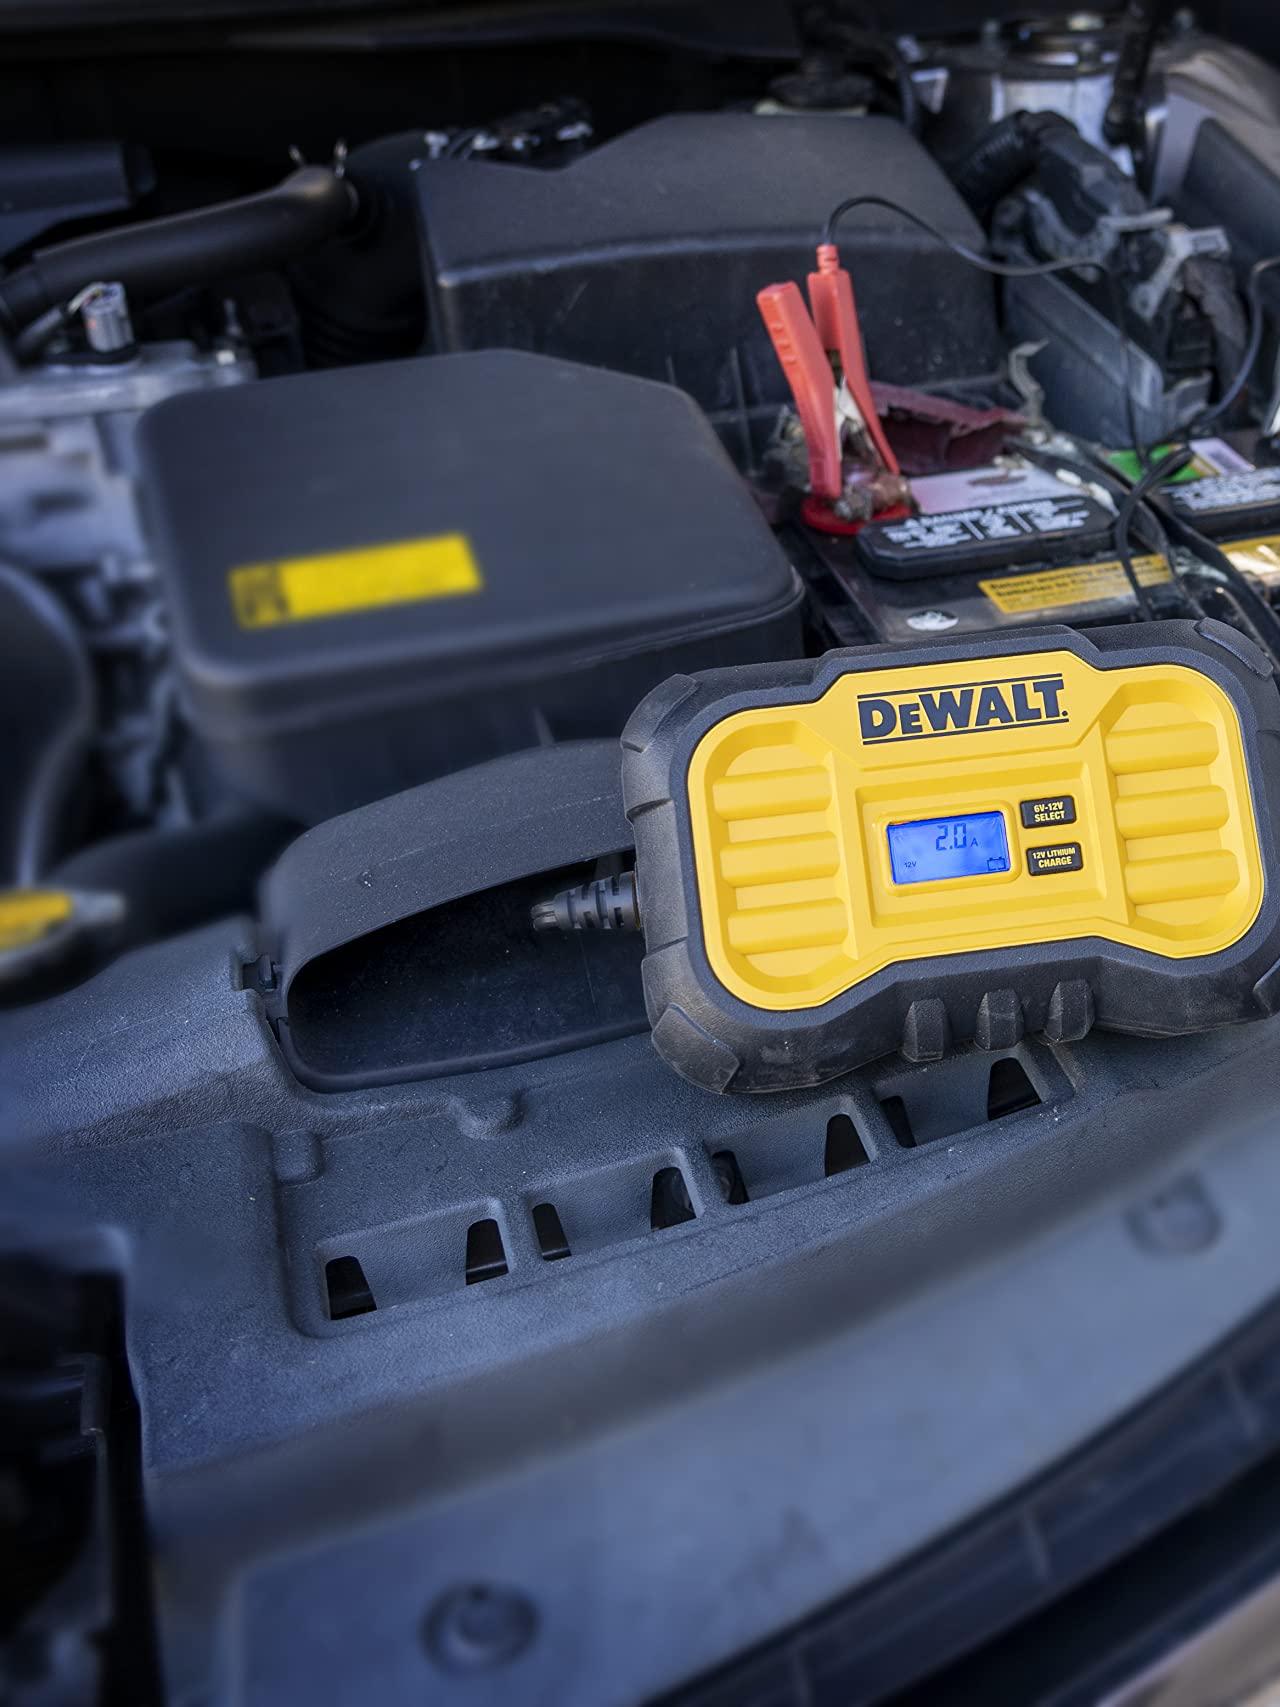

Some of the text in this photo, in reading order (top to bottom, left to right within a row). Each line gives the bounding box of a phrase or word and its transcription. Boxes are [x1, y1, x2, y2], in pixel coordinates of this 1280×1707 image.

[1033, 801, 1064, 813] 6V-12V
[1034, 810, 1065, 822] SELECT
[936, 823, 979, 851] 2.0 A
[1032, 847, 1076, 859] 12V LITHIUM
[1038, 856, 1073, 868] CHARGE
